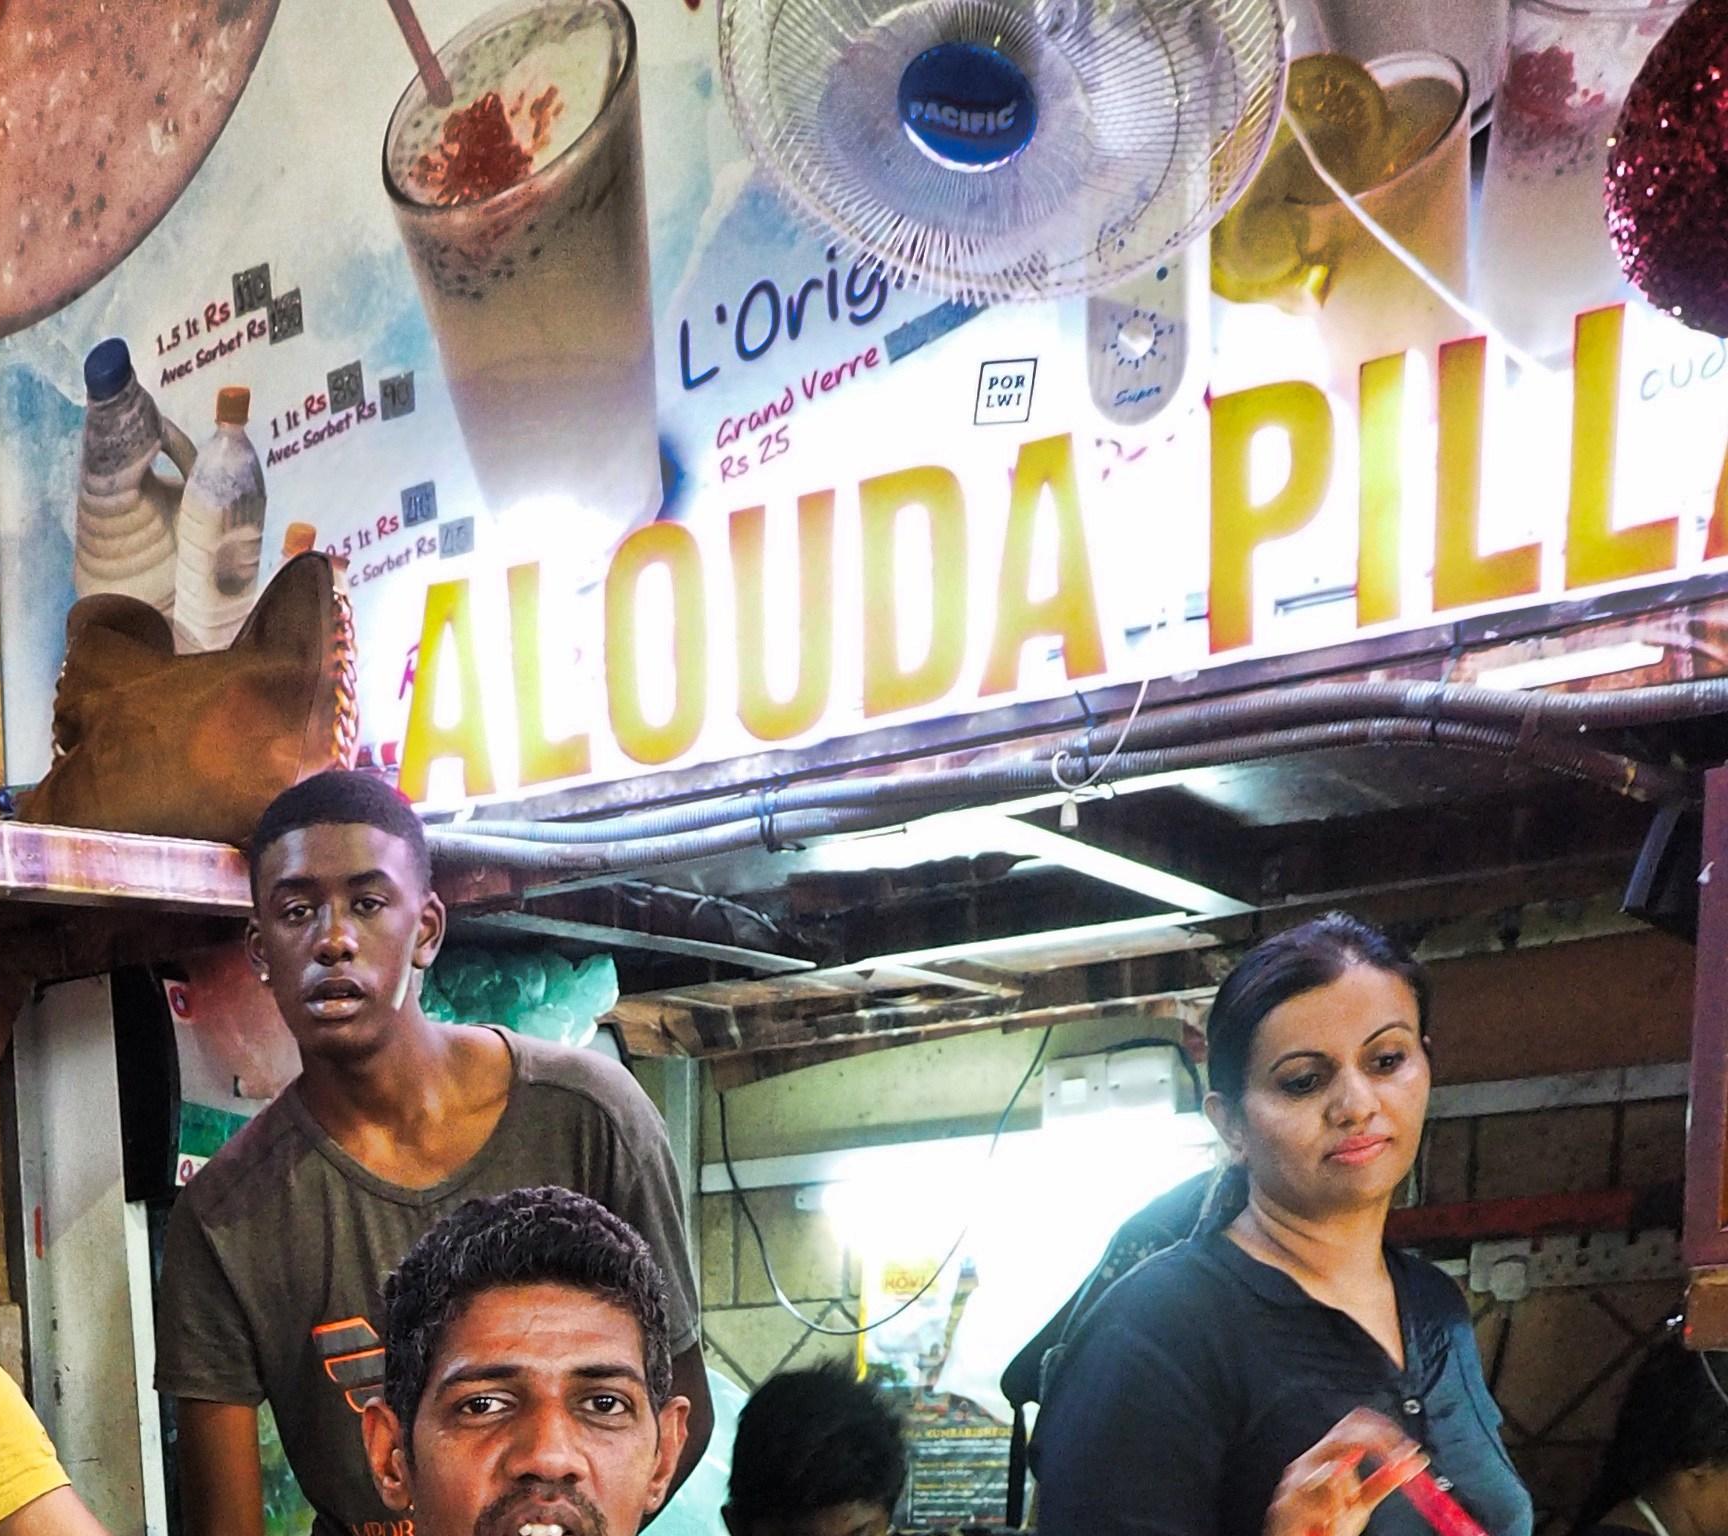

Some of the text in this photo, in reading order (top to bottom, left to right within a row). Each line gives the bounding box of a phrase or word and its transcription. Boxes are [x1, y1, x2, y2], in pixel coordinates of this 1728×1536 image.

[909, 102, 1018, 136] PACIFIC
[156, 325, 181, 357] 1.5
[204, 302, 231, 333] Rs
[679, 243, 912, 392] L'Orig
[161, 359, 193, 388] Avec
[196, 331, 243, 368] Sorbet
[246, 319, 267, 343] Rs
[304, 394, 327, 420] Rs
[716, 346, 880, 449] Grand Verre
[986, 393, 1022, 408] LWI
[988, 375, 1025, 390] POR
[266, 441, 300, 468] Avec
[303, 413, 353, 450] Sorbet
[355, 400, 377, 424] Rs
[719, 425, 790, 483] Rs 25
[376, 515, 400, 540] Rs
[396, 303, 1728, 803] ALOUDA PILL
[363, 546, 411, 583] Sorbet
[416, 536, 437, 559] Rs
